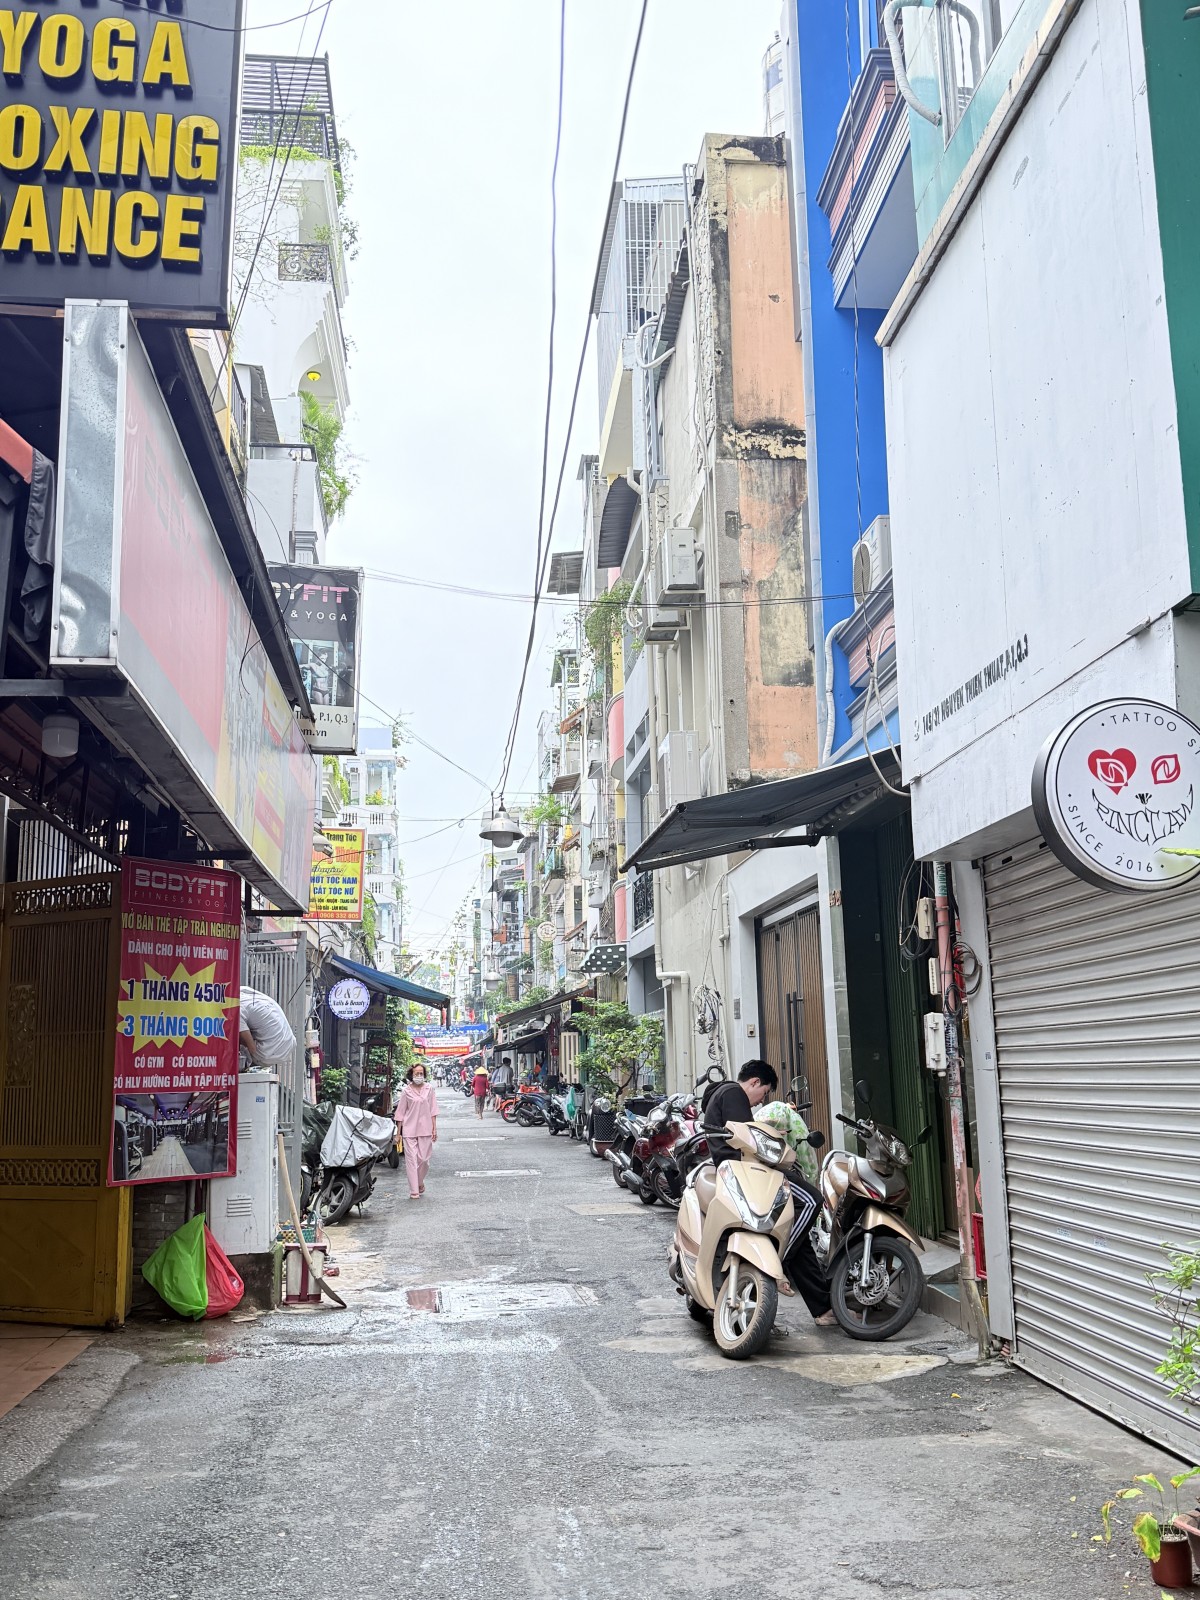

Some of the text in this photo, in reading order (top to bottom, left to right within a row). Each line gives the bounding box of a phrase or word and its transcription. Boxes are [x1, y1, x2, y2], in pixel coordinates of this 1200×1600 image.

[0, 10, 190, 85] YOGA
[0, 185, 204, 262] ANCE
[290, 609, 347, 621] & YOGA
[335, 713, 348, 725] Q.3
[1110, 711, 1177, 732] TATTOO
[301, 728, 327, 737] m.vn
[1068, 805, 1153, 873] SINCE 2016
[135, 868, 228, 897] BODYFIT
[341, 876, 358, 885] NAM
[155, 943, 174, 957] CHO
[175, 943, 190, 960] HỘI
[192, 944, 213, 959] VIÊN
[127, 976, 226, 1004] 1 THÁNG 450K
[123, 1015, 134, 1036] 3
[139, 1011, 188, 1036] THÁNG
[134, 1053, 217, 1069] CÓ GYM CÓ BOXIN
[125, 1076, 140, 1089] HLV
[194, 1072, 213, 1089] TẬP
